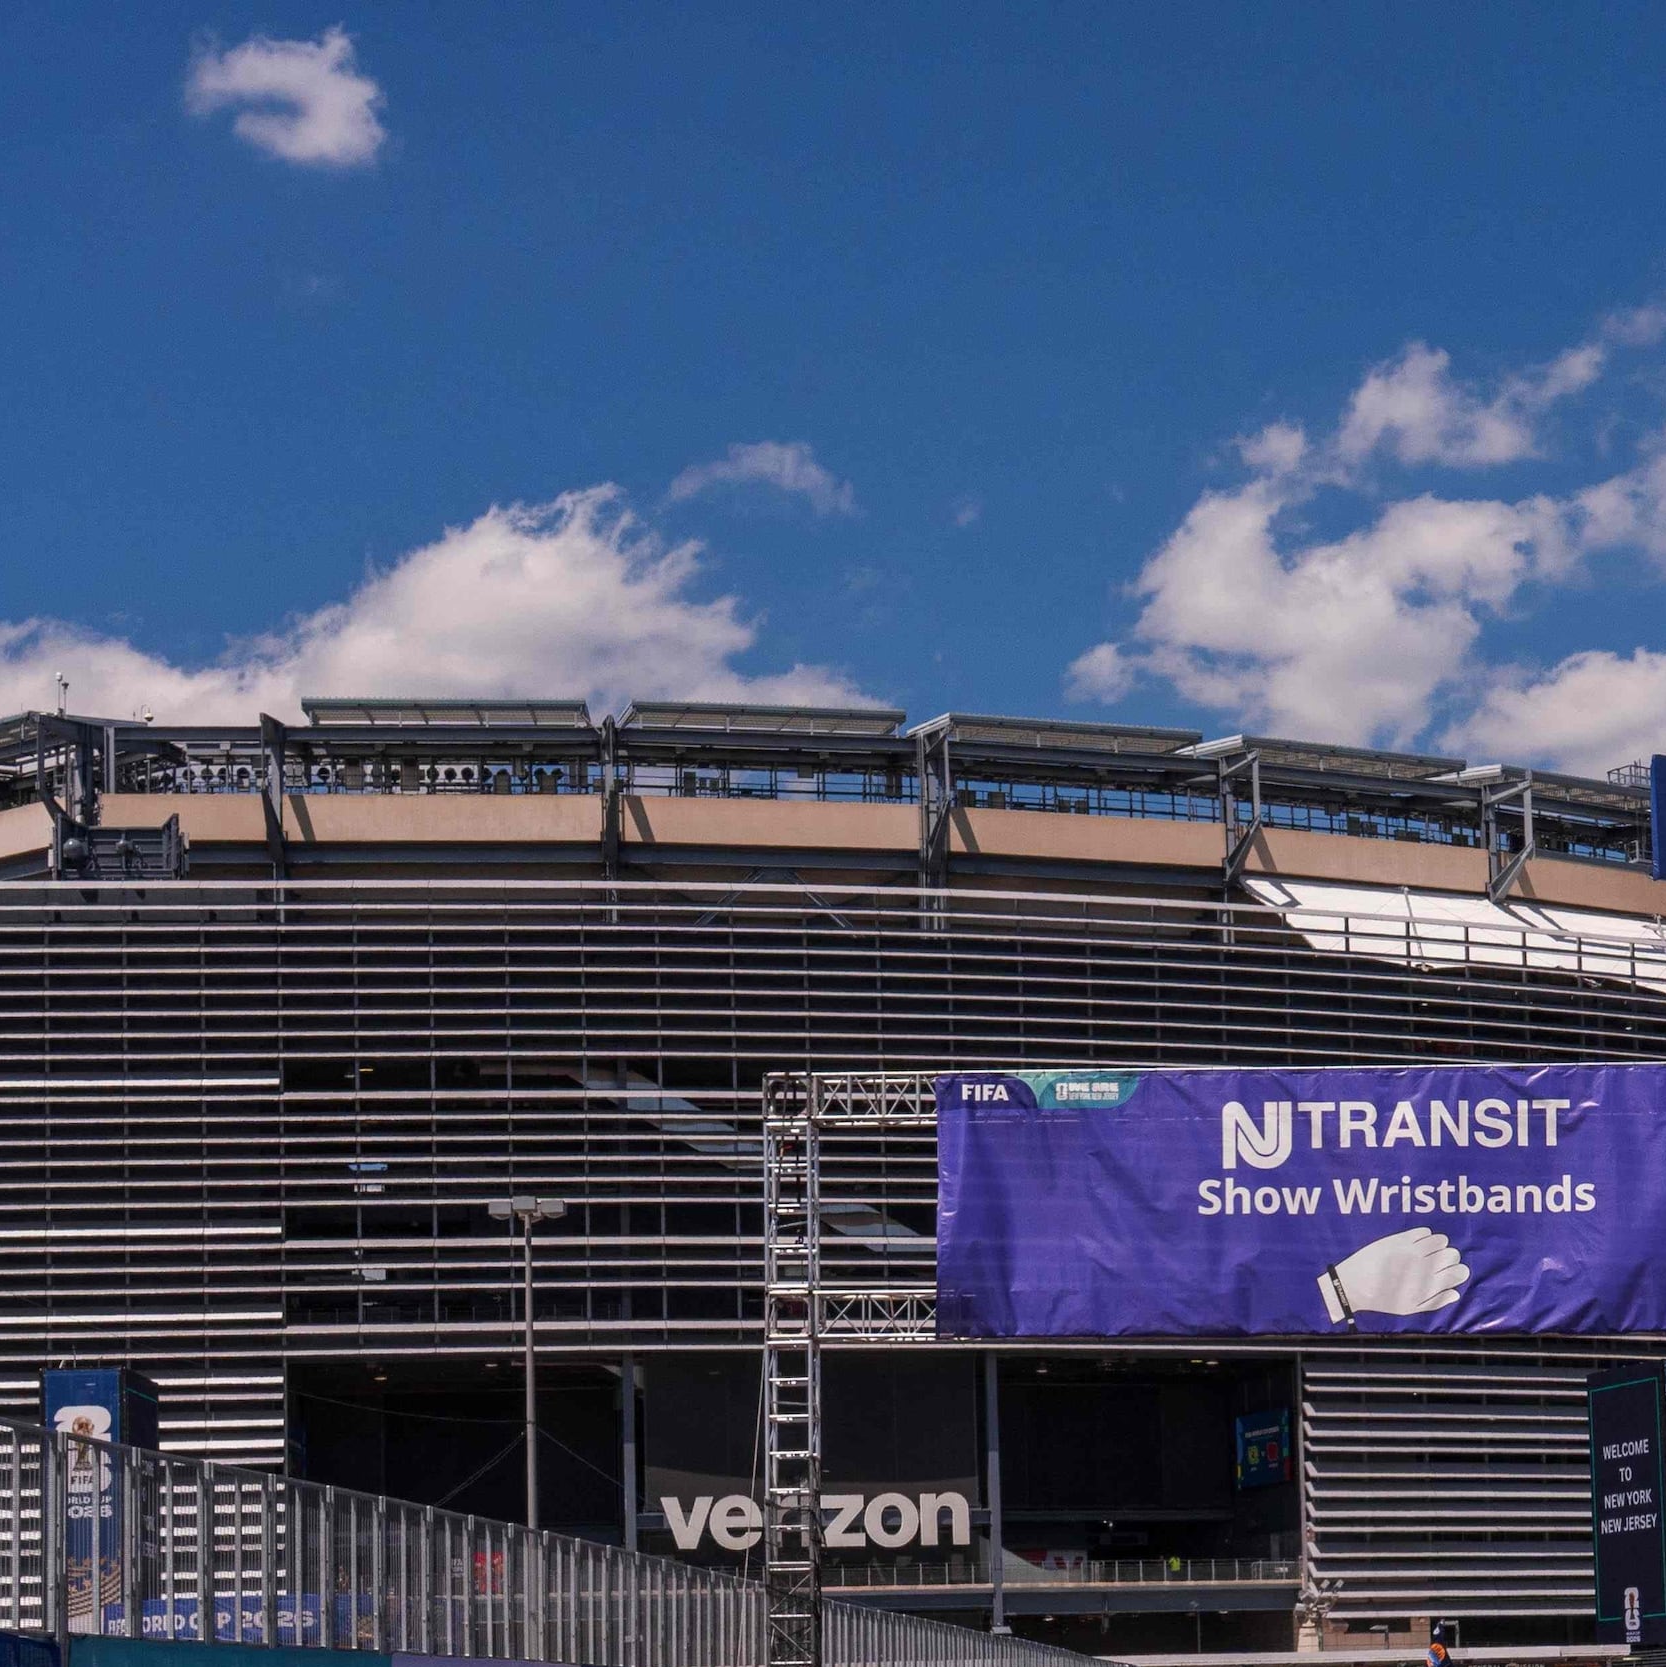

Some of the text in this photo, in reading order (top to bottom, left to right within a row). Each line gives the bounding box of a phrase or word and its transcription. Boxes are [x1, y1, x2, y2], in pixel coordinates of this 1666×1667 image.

[962, 1084, 1009, 1101] FIFA
[1297, 1099, 1572, 1150] TRANSIT
[1197, 1175, 1597, 1217] Show Wristbands
[1603, 1439, 1649, 1460] WELCOME
[1619, 1467, 1632, 1482] TO
[1604, 1489, 1652, 1510] NEW YORK
[660, 1492, 971, 1550] verizon
[1601, 1513, 1658, 1534] NEW JERSEY
